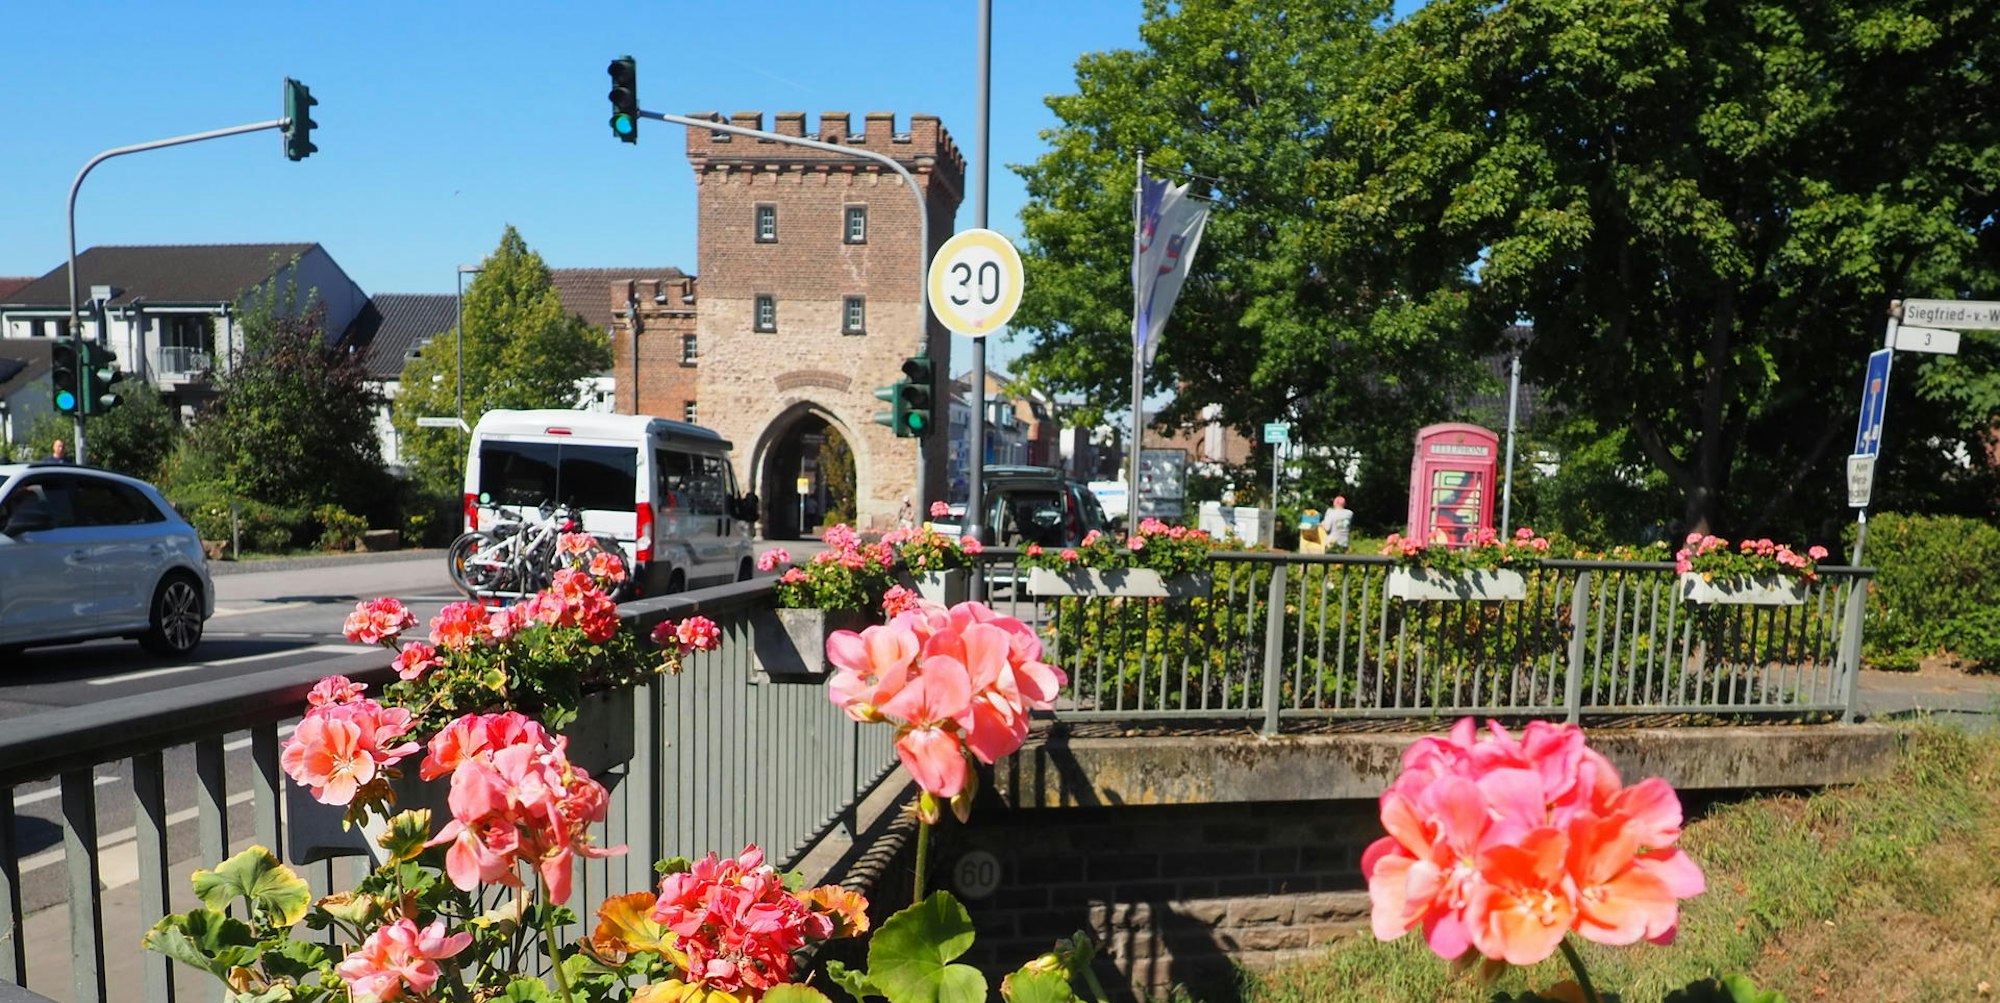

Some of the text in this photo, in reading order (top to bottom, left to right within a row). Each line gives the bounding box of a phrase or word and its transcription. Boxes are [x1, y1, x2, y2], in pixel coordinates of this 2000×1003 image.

[951, 260, 1000, 306] 30
[1924, 332, 1932, 346] 3
[1433, 445, 1485, 456] TELEPHONE
[962, 861, 994, 887] 60
